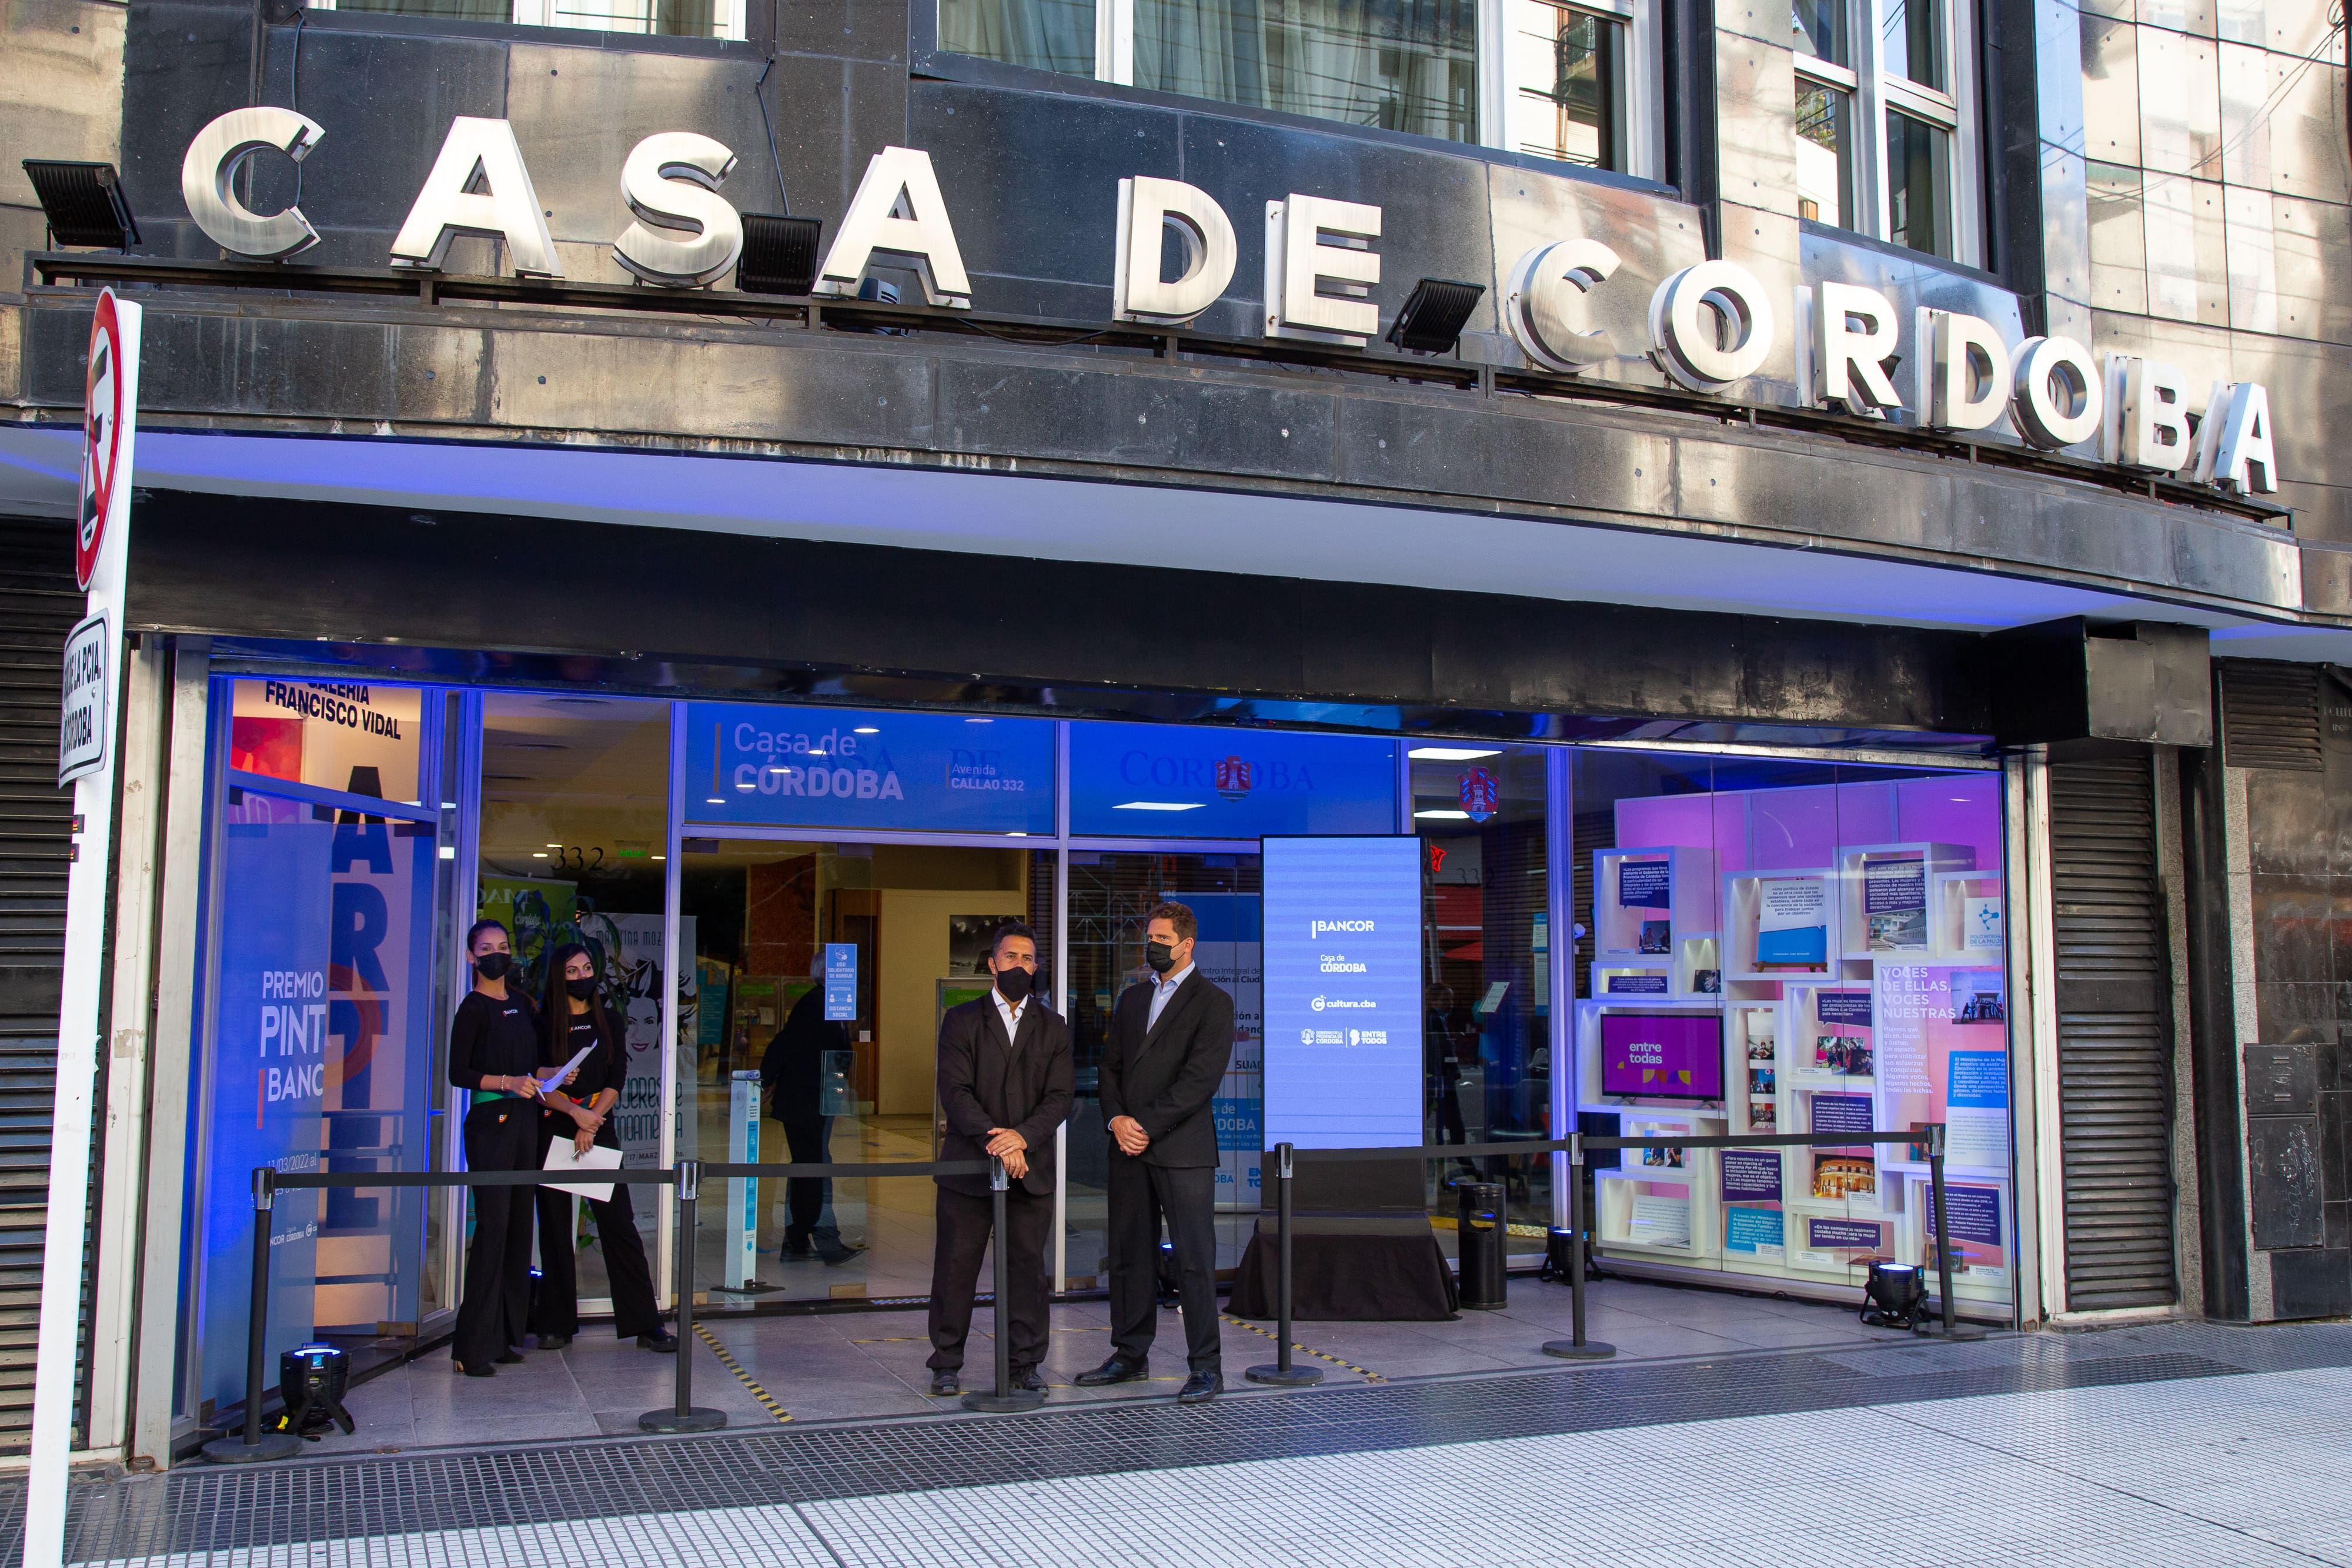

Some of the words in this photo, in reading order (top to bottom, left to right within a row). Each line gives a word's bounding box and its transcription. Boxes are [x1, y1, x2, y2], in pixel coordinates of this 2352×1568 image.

[181, 106, 973, 310] CASA
[1113, 175, 1382, 347] DE
[1505, 238, 2279, 496] CORDOBA
[82, 641, 101, 686] PCIA.
[266, 680, 358, 728] FRANCISCO
[362, 708, 401, 740] VIDAL
[734, 723, 809, 756] Casa
[821, 728, 856, 756] de
[952, 763, 995, 776] Avenida
[734, 756, 904, 800] CÓRDOBA
[951, 778, 1000, 791] CALLAO
[1003, 779, 1024, 791] 332
[550, 847, 604, 870] 332
[1318, 921, 1375, 931] BANCOR
[1222, 967, 1250, 975] Integral
[1321, 960, 1367, 972] CÓRDOBA
[1882, 967, 1928, 978] VOCES
[262, 971, 323, 999] PREMIO
[1883, 981, 1901, 992] DE
[1905, 980, 1951, 994] ELLAS,
[1327, 999, 1376, 1008] cultura.cba
[1883, 994, 1929, 1005] VOCES
[1883, 1008, 1956, 1019] NUESTRAS
[260, 1004, 327, 1058] PINT
[1629, 1042, 1662, 1052] entre
[1629, 1052, 1663, 1064] todas
[268, 1063, 325, 1102] BANC
[1221, 1102, 1235, 1114] de
[1214, 1118, 1256, 1131] DOBA
